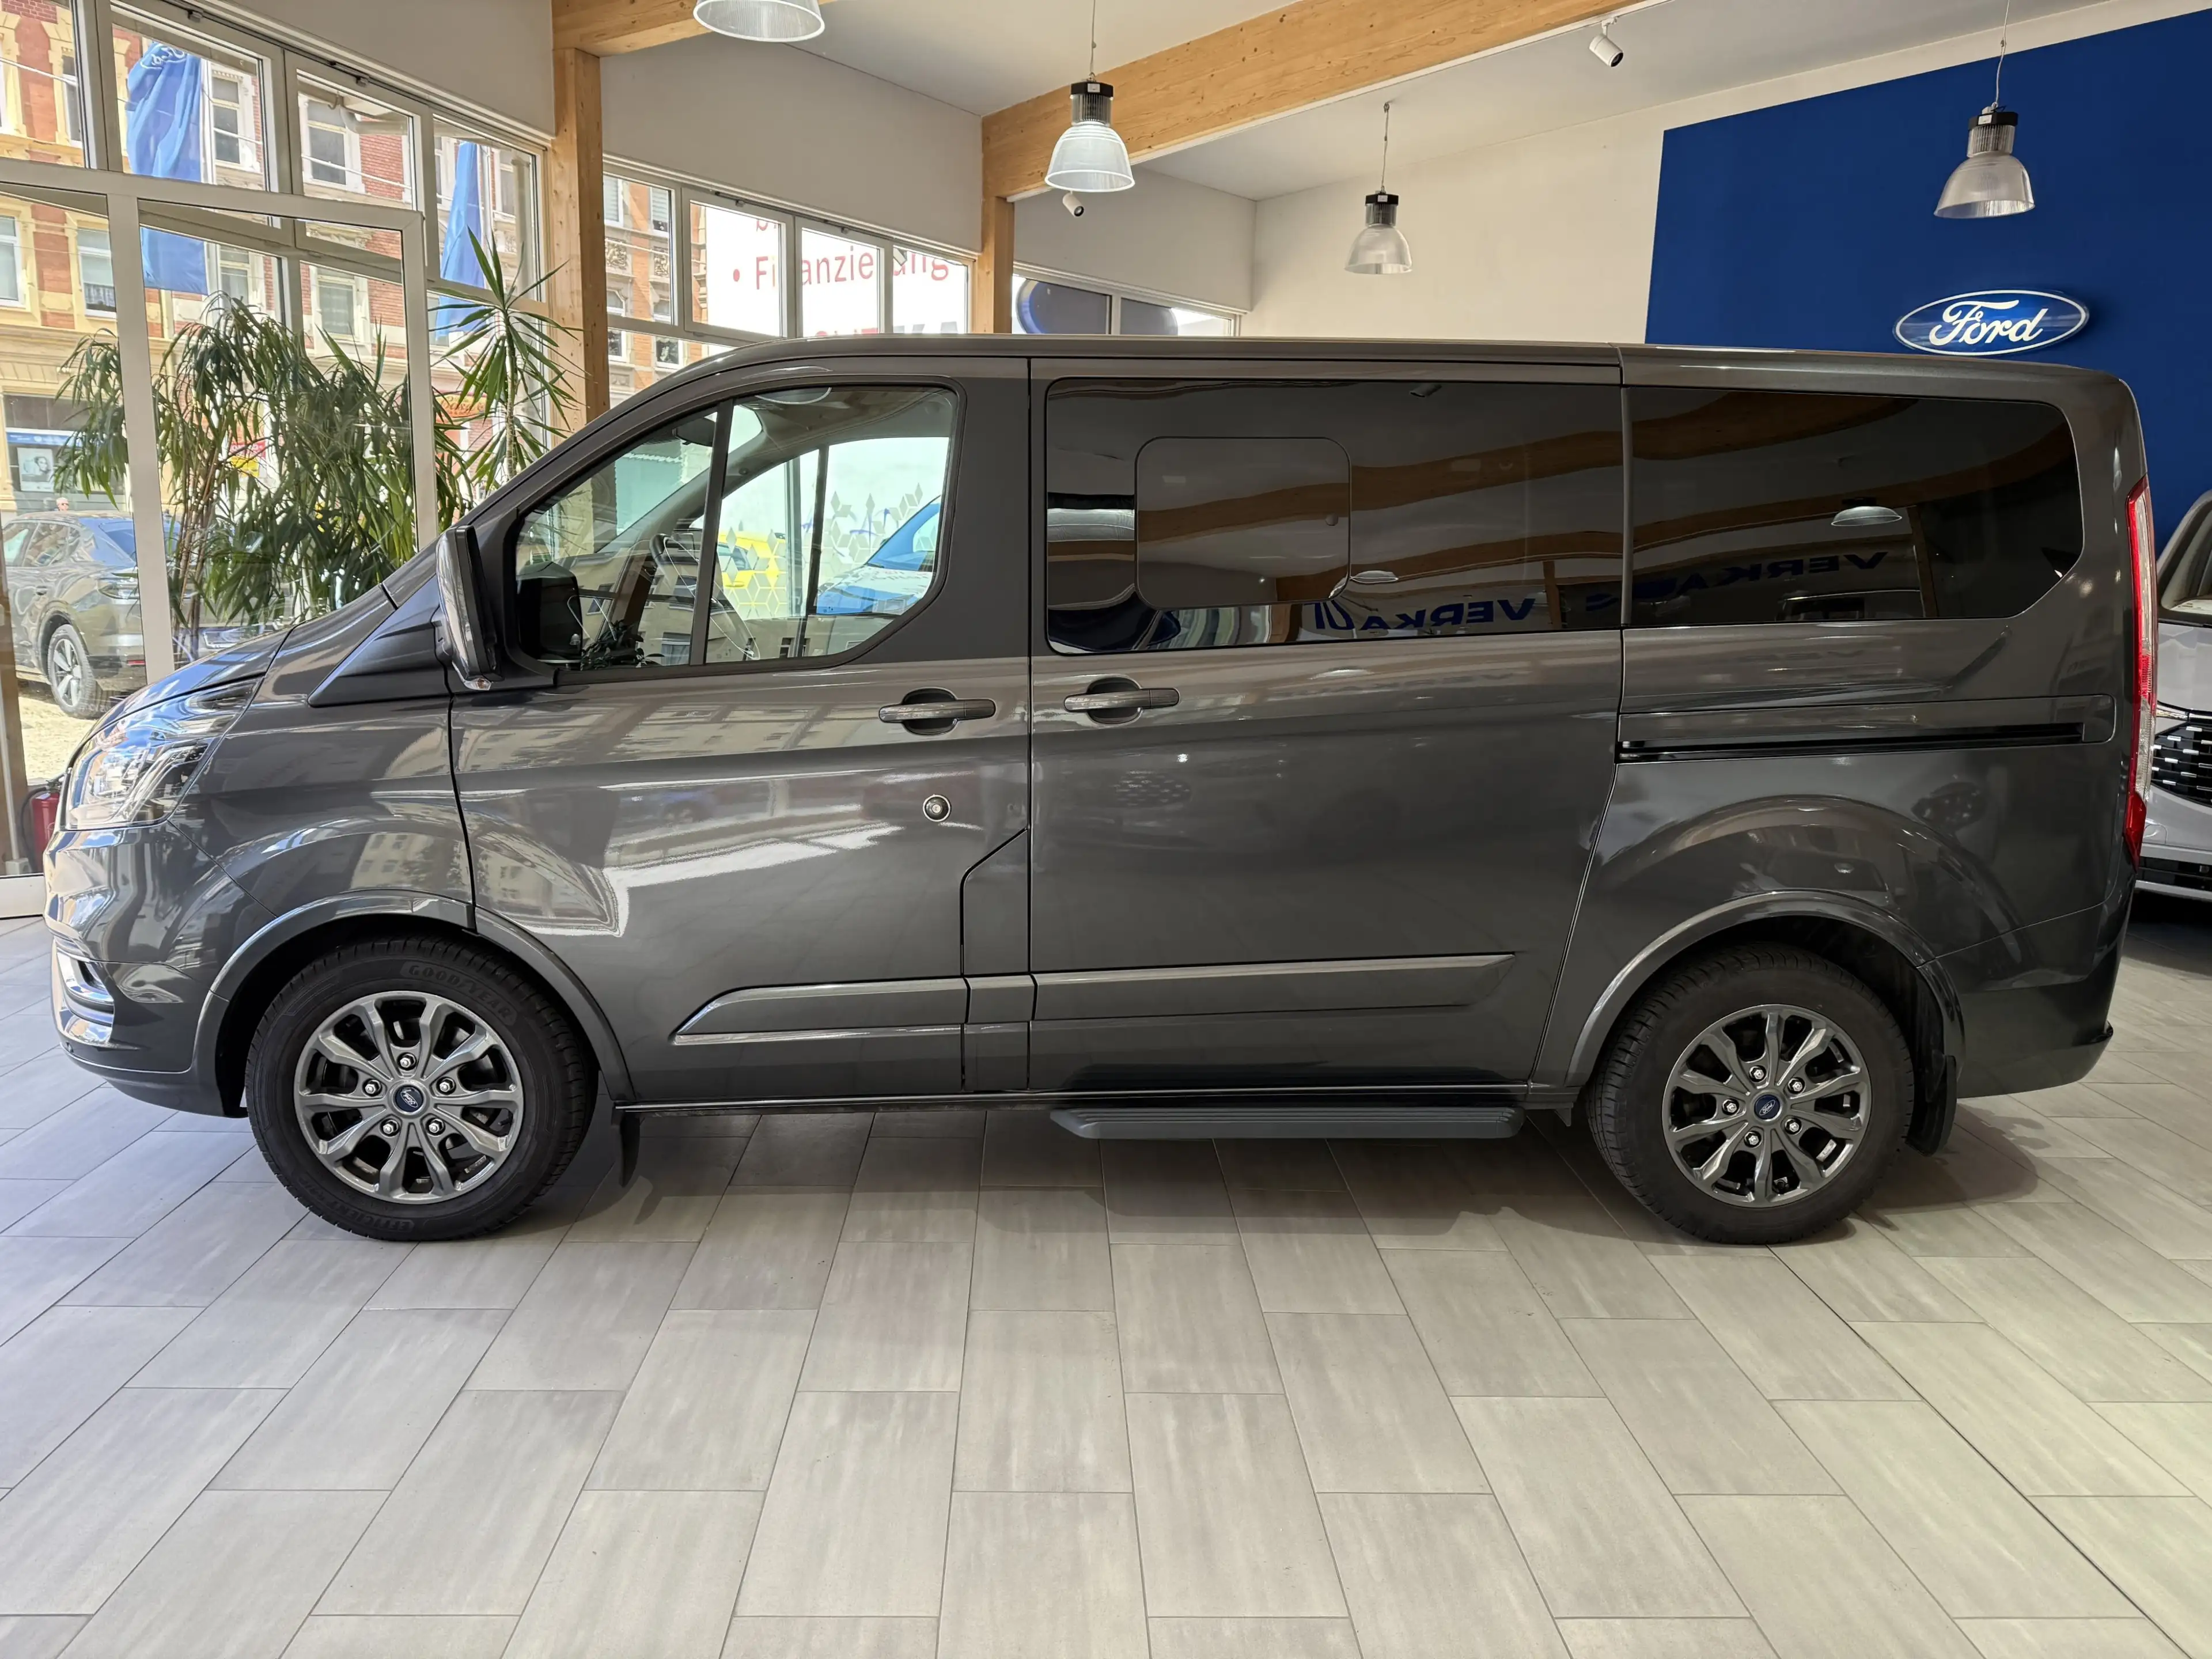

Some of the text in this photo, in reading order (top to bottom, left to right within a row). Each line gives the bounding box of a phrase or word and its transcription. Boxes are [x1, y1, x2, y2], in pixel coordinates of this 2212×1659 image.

[756, 245, 949, 290] Fianzieng
[1929, 300, 2048, 346] Ford
[408, 964, 513, 1020] GOODYEAR
